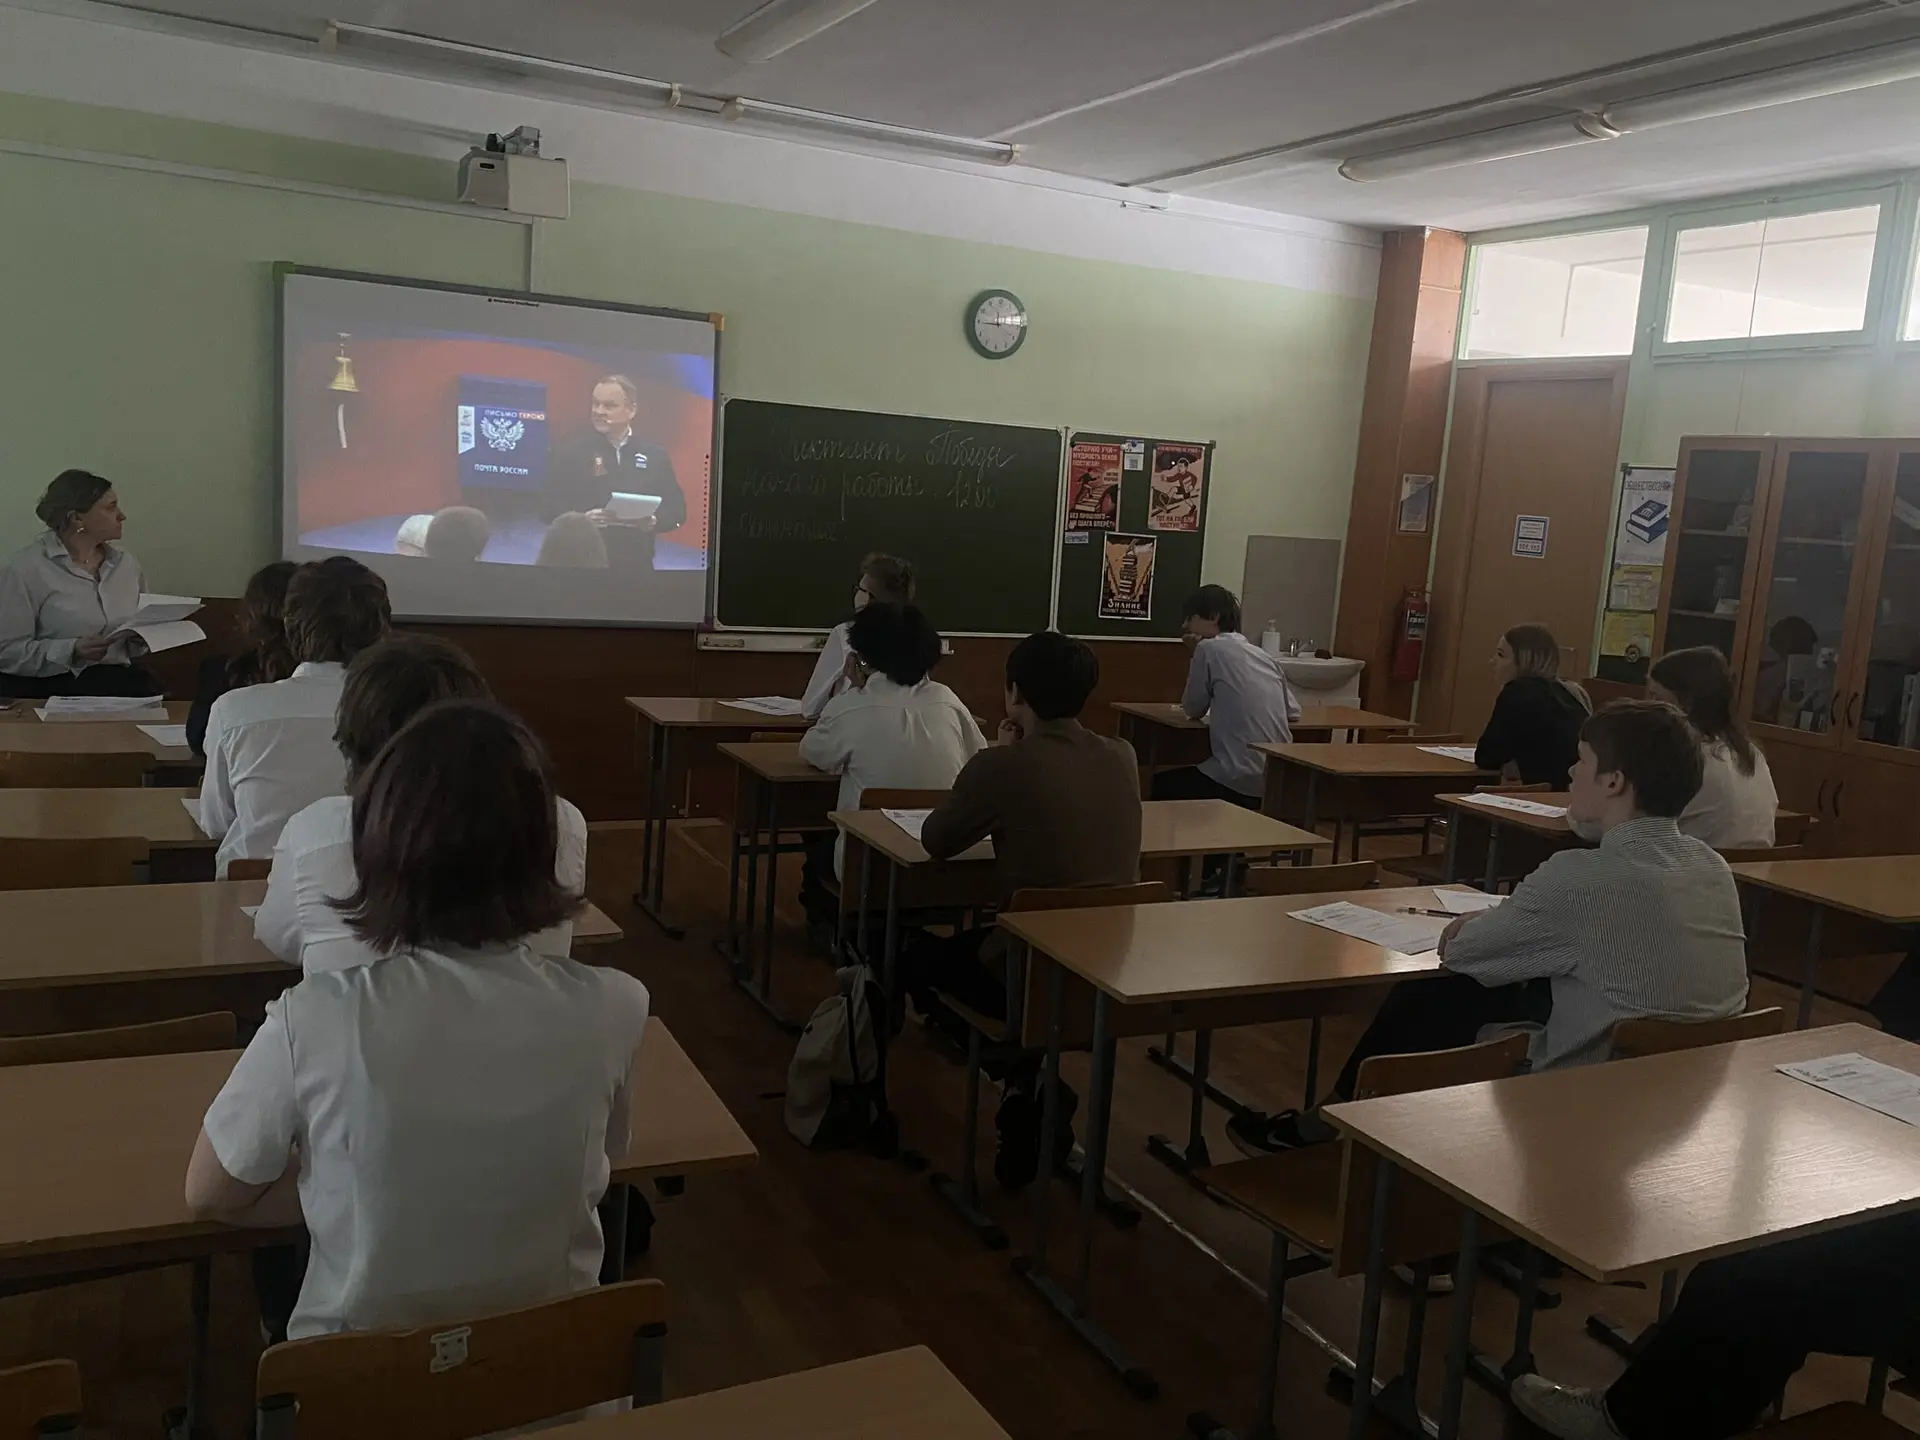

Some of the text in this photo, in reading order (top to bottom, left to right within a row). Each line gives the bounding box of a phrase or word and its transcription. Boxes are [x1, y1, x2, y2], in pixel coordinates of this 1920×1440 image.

[484, 409, 545, 421] ПИСЬМО ГЕРОЮ
[474, 463, 529, 475] ПОЧТА РОССИИ
